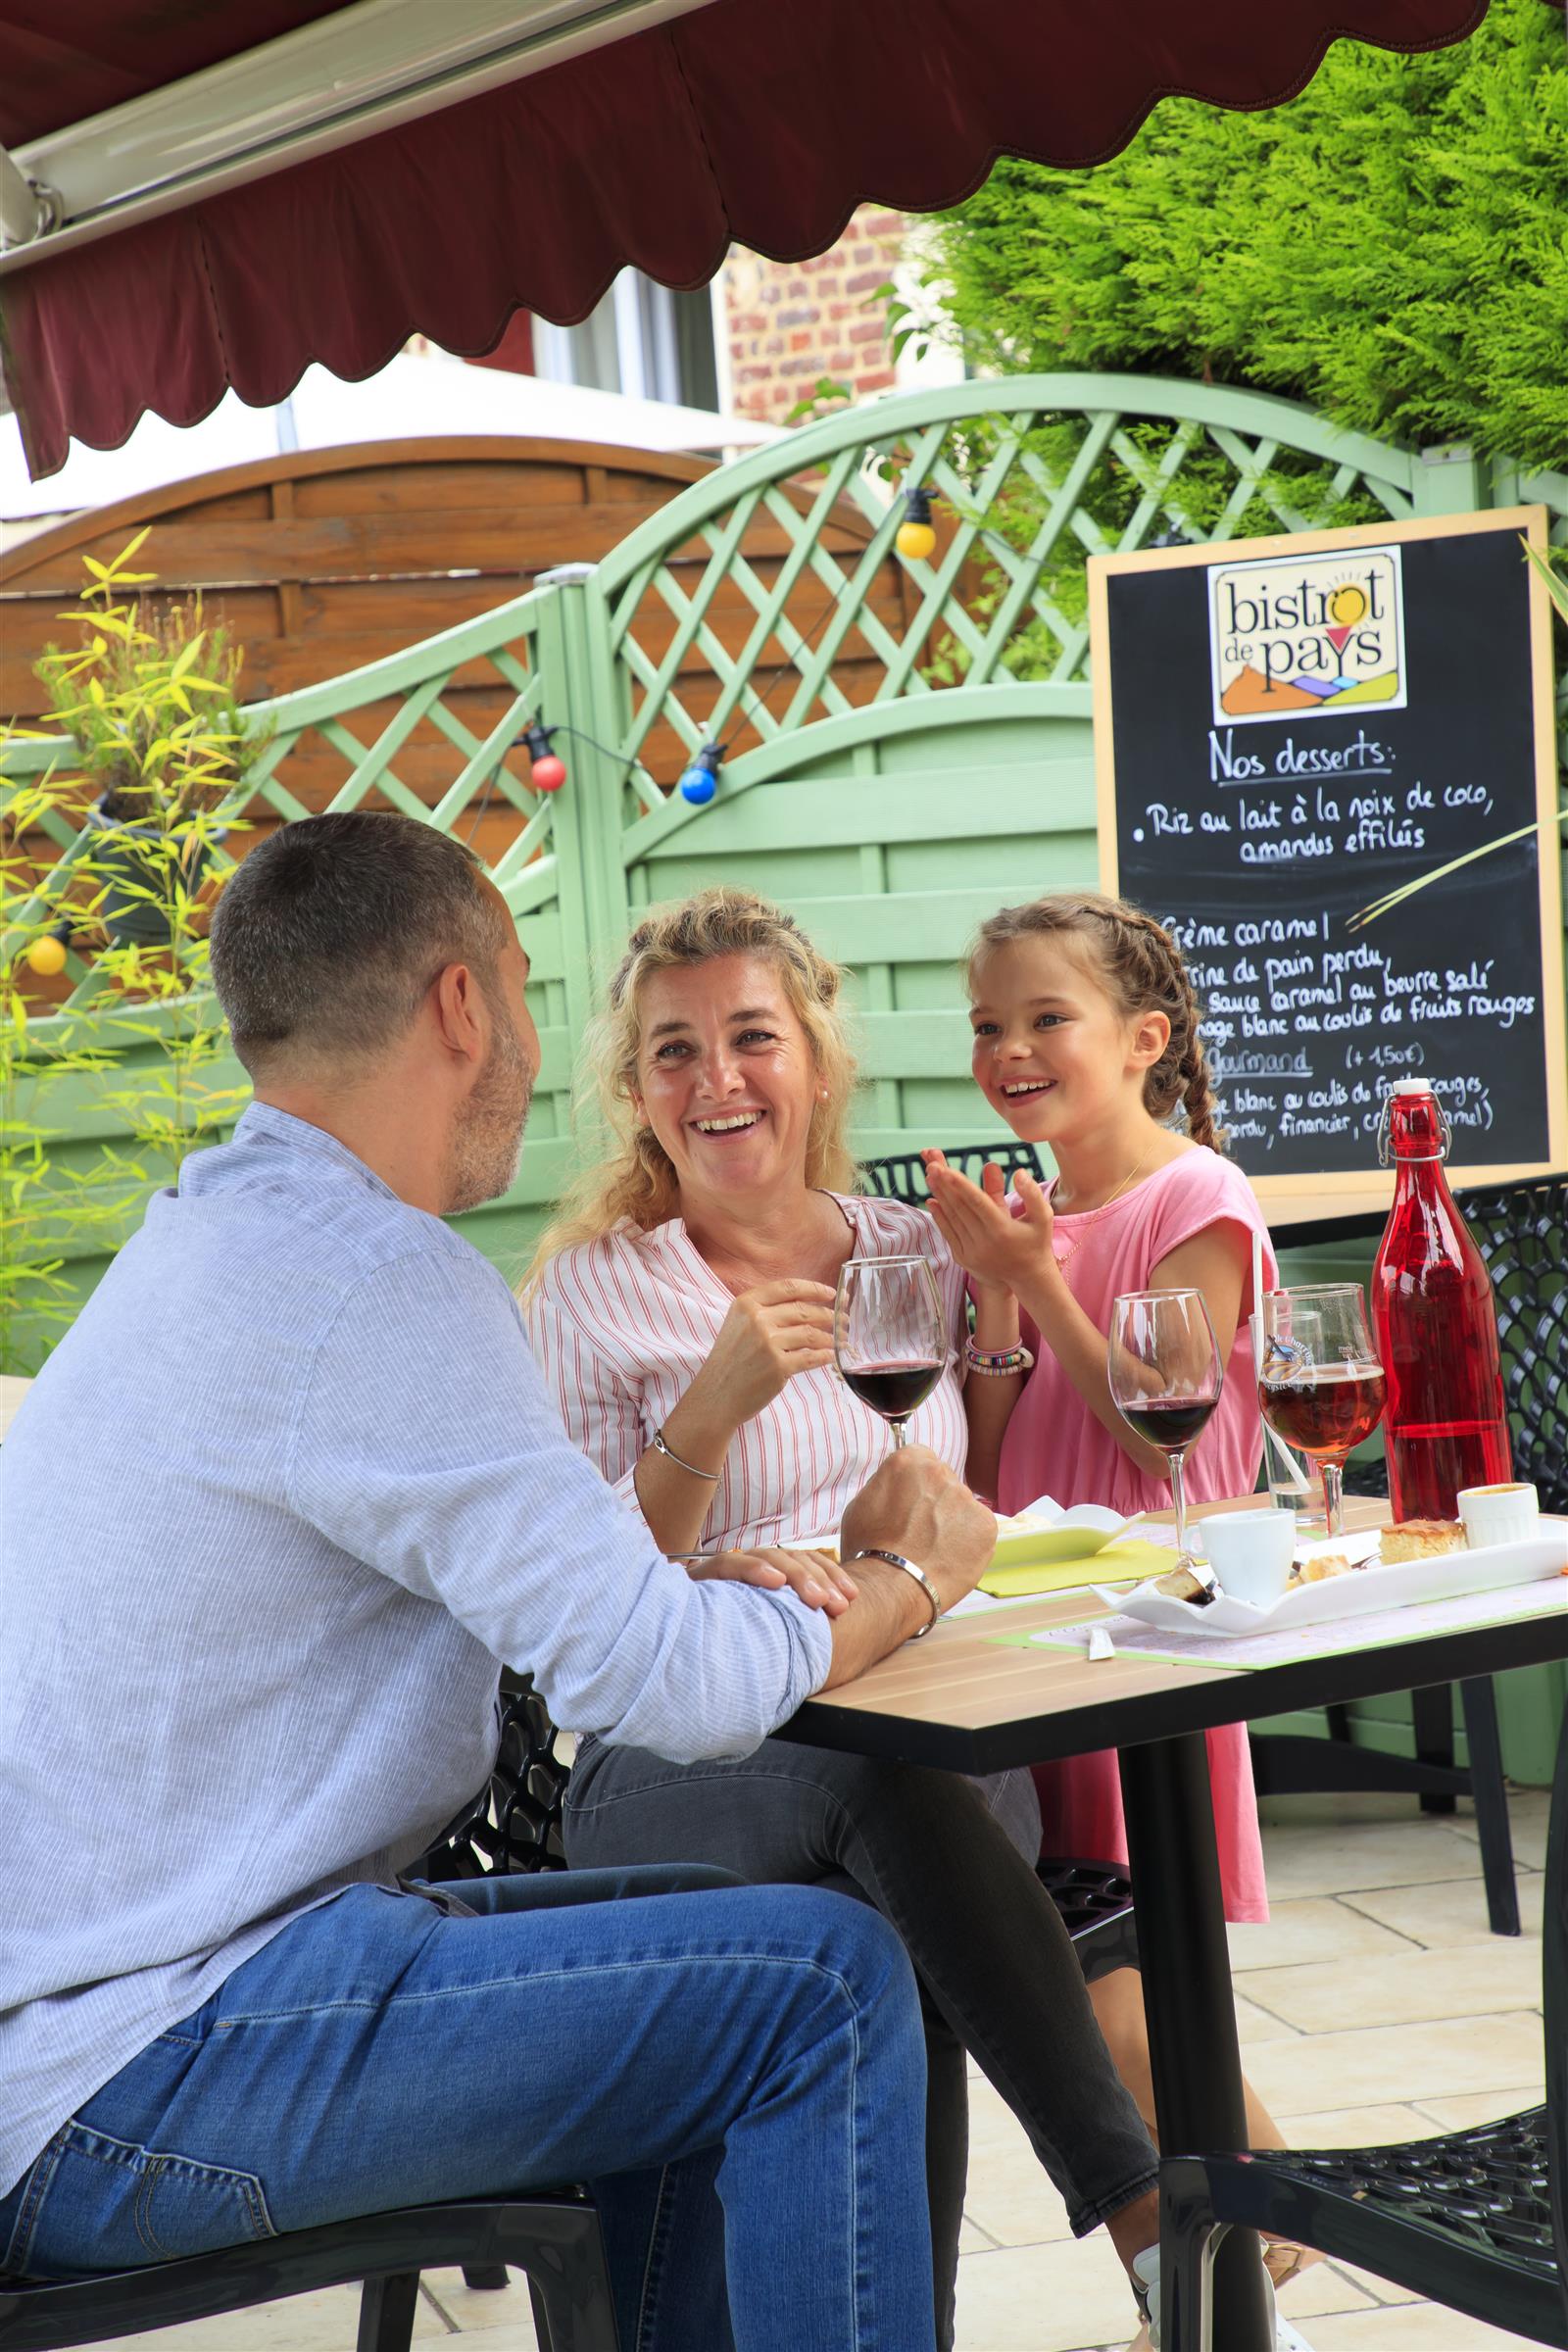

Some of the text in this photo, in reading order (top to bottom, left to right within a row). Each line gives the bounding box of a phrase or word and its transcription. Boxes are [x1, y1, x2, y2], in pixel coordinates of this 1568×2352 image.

[1225, 569, 1385, 635] bistrot
[1225, 629, 1382, 694] de pays
[1208, 728, 1266, 781] Nos
[1146, 803, 1194, 836] Riz
[1200, 811, 1232, 833] au
[1239, 798, 1283, 831] lait
[1291, 793, 1308, 825] à
[1317, 786, 1341, 822] la
[1348, 789, 1396, 819] noix
[1406, 780, 1436, 811] de
[1240, 818, 1426, 862] amandes effilés
[1234, 910, 1329, 947] caramel
[1208, 958, 1494, 1014] sauce caramel au beurre salé
[1233, 956, 1260, 985] de
[1264, 950, 1314, 995] pain
[1241, 1013, 1290, 1039] blanc
[1294, 1014, 1322, 1033] au
[1323, 1003, 1373, 1032] coulis
[1380, 1001, 1402, 1024] de
[1409, 993, 1463, 1022] fruits
[1468, 995, 1536, 1029] rouges
[1235, 1088, 1277, 1113] blanc
[1284, 1093, 1303, 1110] au
[1307, 1079, 1348, 1108] coulis
[1351, 1081, 1371, 1104] de
